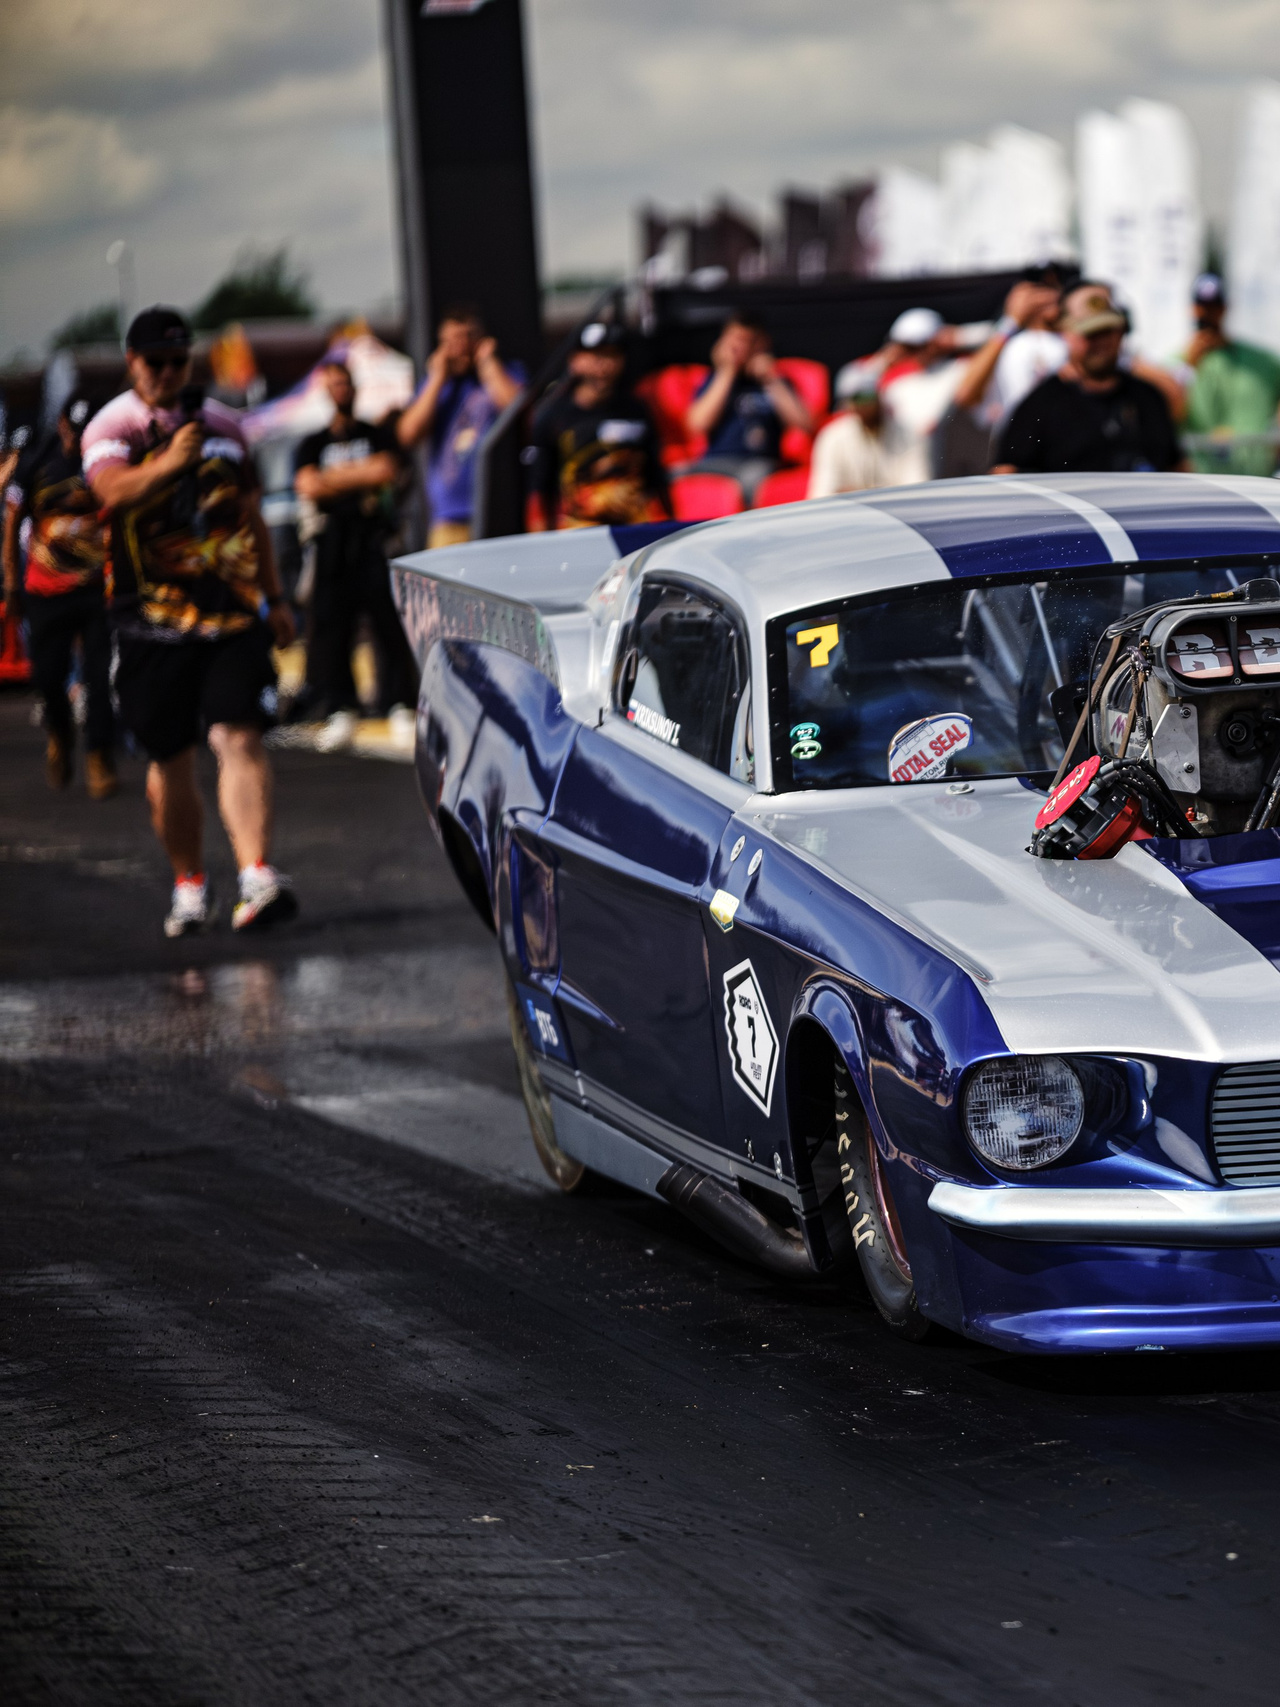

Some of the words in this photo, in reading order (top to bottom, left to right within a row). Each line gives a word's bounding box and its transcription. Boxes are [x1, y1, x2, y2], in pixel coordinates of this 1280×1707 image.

[796, 624, 840, 668] 7
[892, 749, 934, 781] TOTAL
[929, 724, 967, 757] SEAL
[746, 1014, 757, 1058] 7
